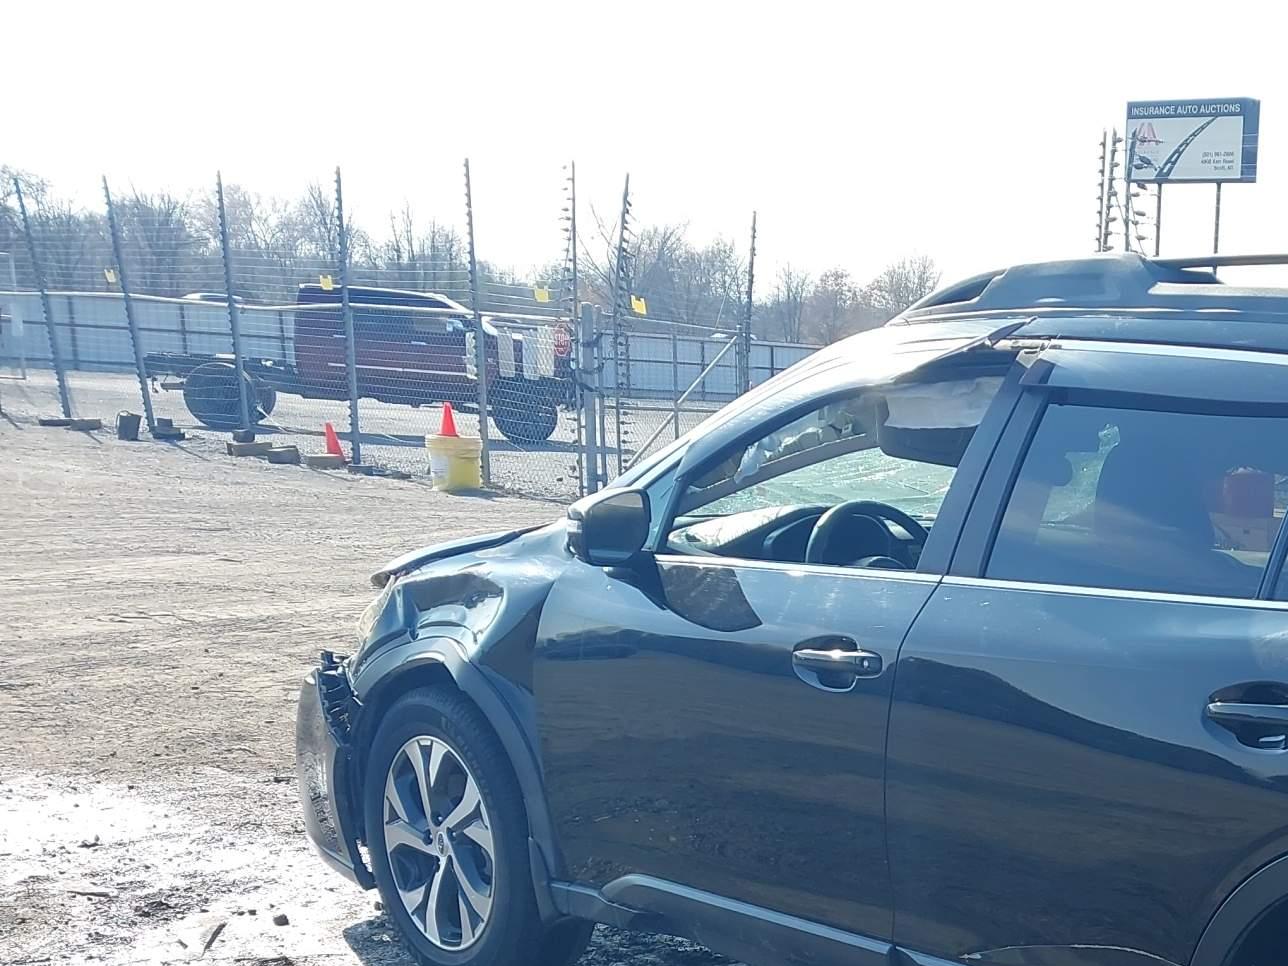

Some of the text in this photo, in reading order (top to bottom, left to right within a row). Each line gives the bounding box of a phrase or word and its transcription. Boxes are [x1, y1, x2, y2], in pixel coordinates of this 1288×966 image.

[1131, 103, 1241, 116] INSURANCE AUTO AUCTIONS
